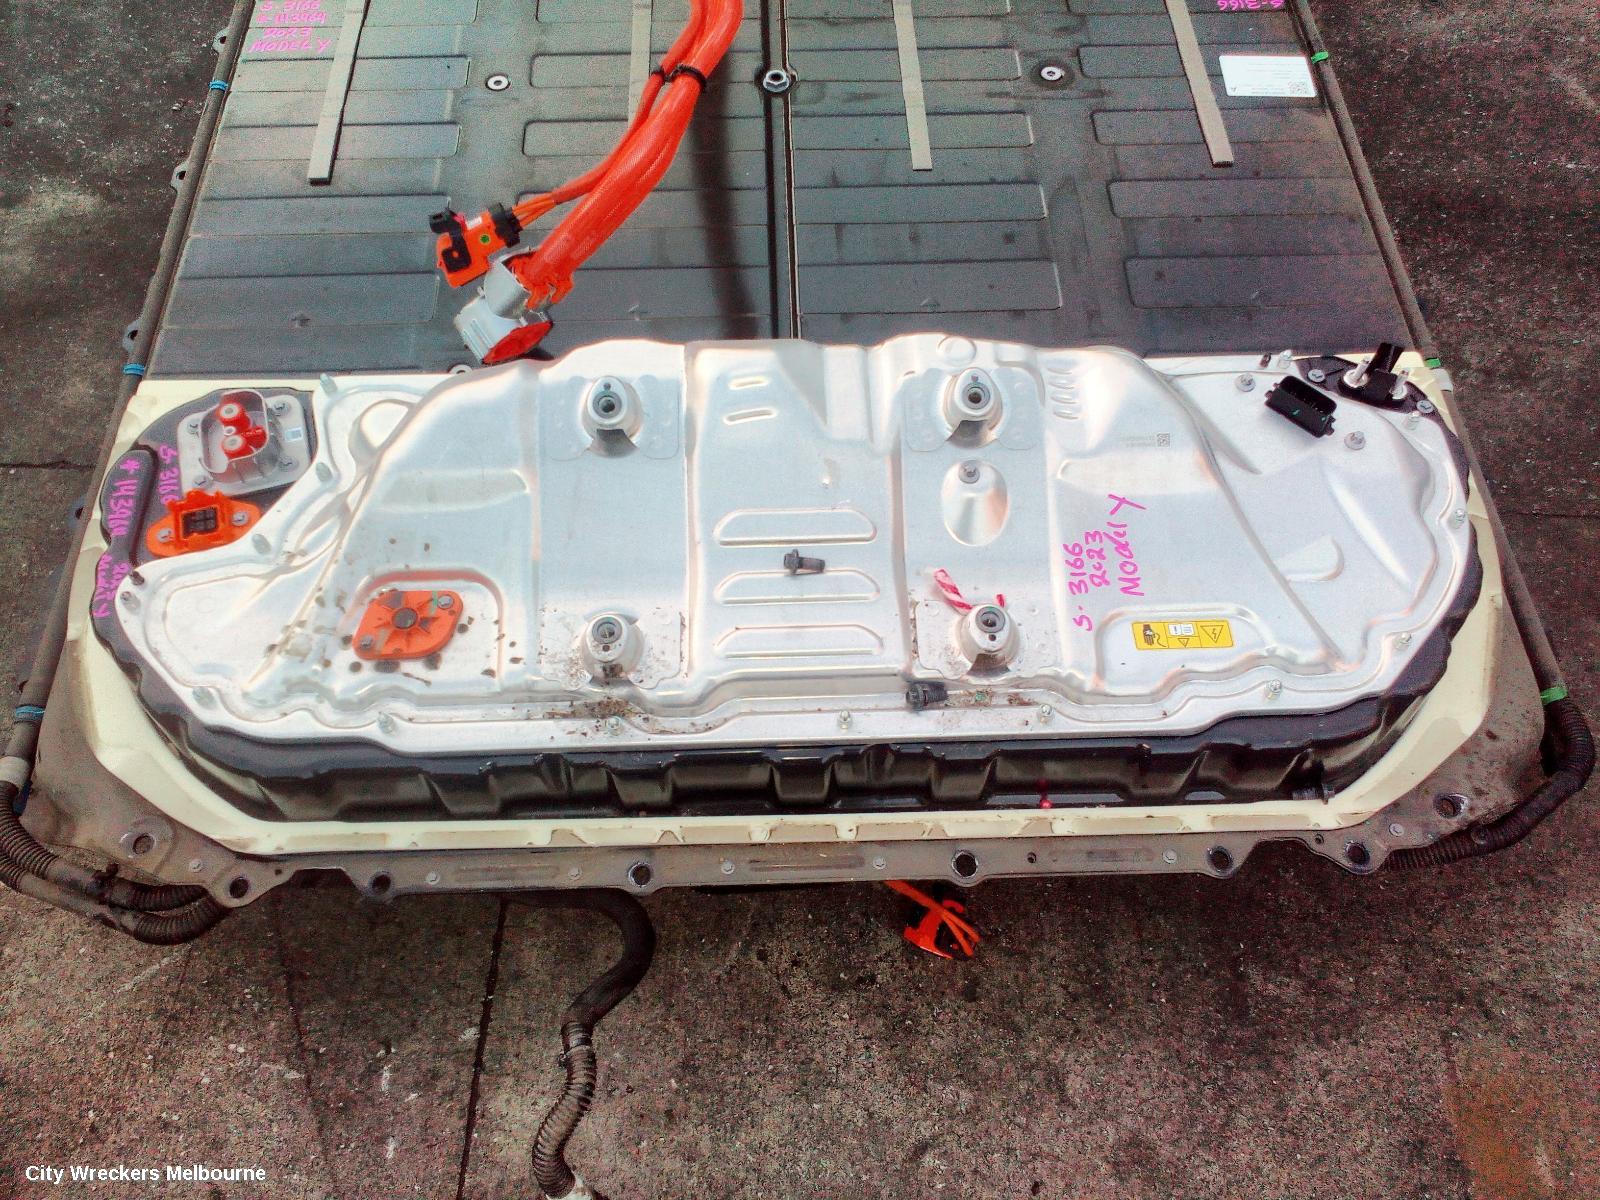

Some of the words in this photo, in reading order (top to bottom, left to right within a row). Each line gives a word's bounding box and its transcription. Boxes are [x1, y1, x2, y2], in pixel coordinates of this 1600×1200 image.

[316, 37, 332, 53] Y
[1107, 493, 1147, 516] Y
[1062, 542, 1089, 596] 3166
